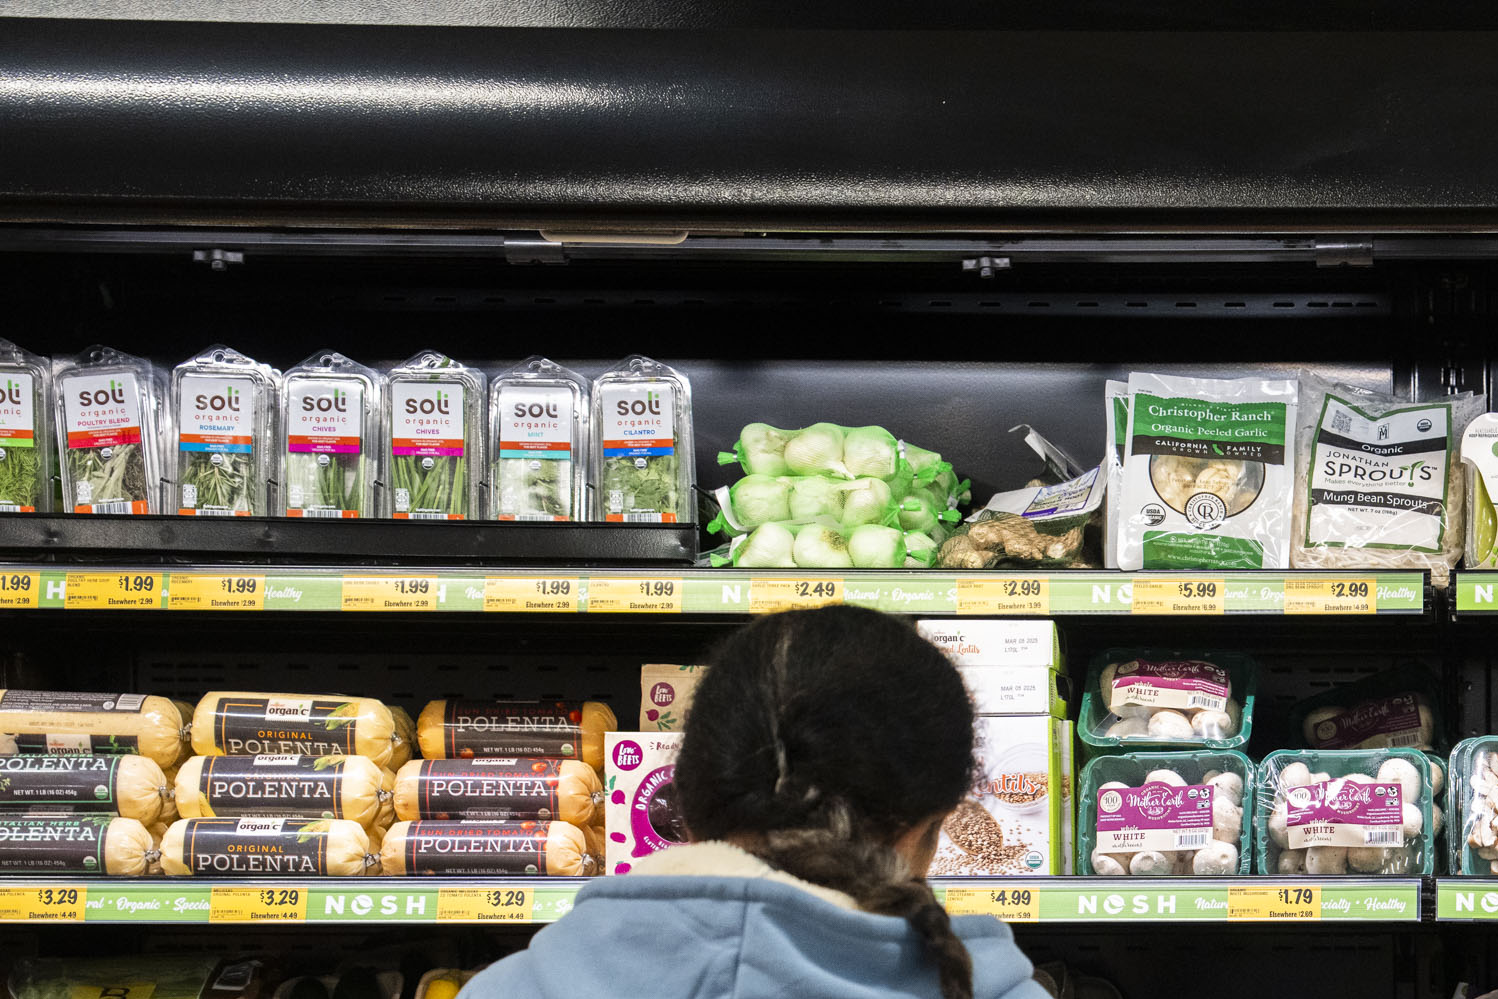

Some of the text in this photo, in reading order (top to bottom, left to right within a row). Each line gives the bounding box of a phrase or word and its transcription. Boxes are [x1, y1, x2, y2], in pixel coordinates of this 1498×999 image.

[80, 408, 126, 418] organic
[194, 414, 239, 422] organic
[1149, 404, 1227, 422] Christopher
[1231, 410, 1272, 422] Ranch
[77, 419, 107, 427] POULTRY
[199, 424, 235, 432] ROSEMARY
[617, 418, 661, 426] organic
[1151, 423, 1268, 438] Organic Peeled Garlic
[1156, 440, 1208, 450] CALIFORNIA
[1227, 445, 1262, 453] FAMILY
[1362, 445, 1403, 454] Organic
[1326, 451, 1389, 467] JONATHAN
[1323, 492, 1427, 508] Mung Bean Sprouts
[119, 575, 153, 591] $1.99
[222, 578, 256, 593] $1.99
[394, 580, 429, 595] $1.99
[795, 582, 835, 598] $2.49
[1003, 580, 1041, 596] $2.99
[1178, 582, 1216, 597] $5.99
[1331, 582, 1368, 597] $2.99
[258, 730, 313, 739] ORIGINAL
[228, 738, 344, 756] POLENTA
[618, 754, 639, 766] BEETS
[212, 782, 331, 798] POLENTA
[431, 780, 548, 797] POLENTA
[1126, 791, 1184, 808] Mother Earth
[1303, 826, 1335, 834] WHITE
[228, 845, 284, 853] ORIGINAL
[418, 838, 536, 853] POLENTA
[197, 854, 317, 872] POLENTA
[38, 889, 78, 905] $3.29
[260, 890, 299, 905] $3.29
[486, 890, 525, 907] $3.29
[991, 890, 1031, 906] $4.99
[1278, 888, 1313, 905] $1.79
[1078, 895, 1176, 914] NOSH
[1364, 897, 1406, 913] Healthy
